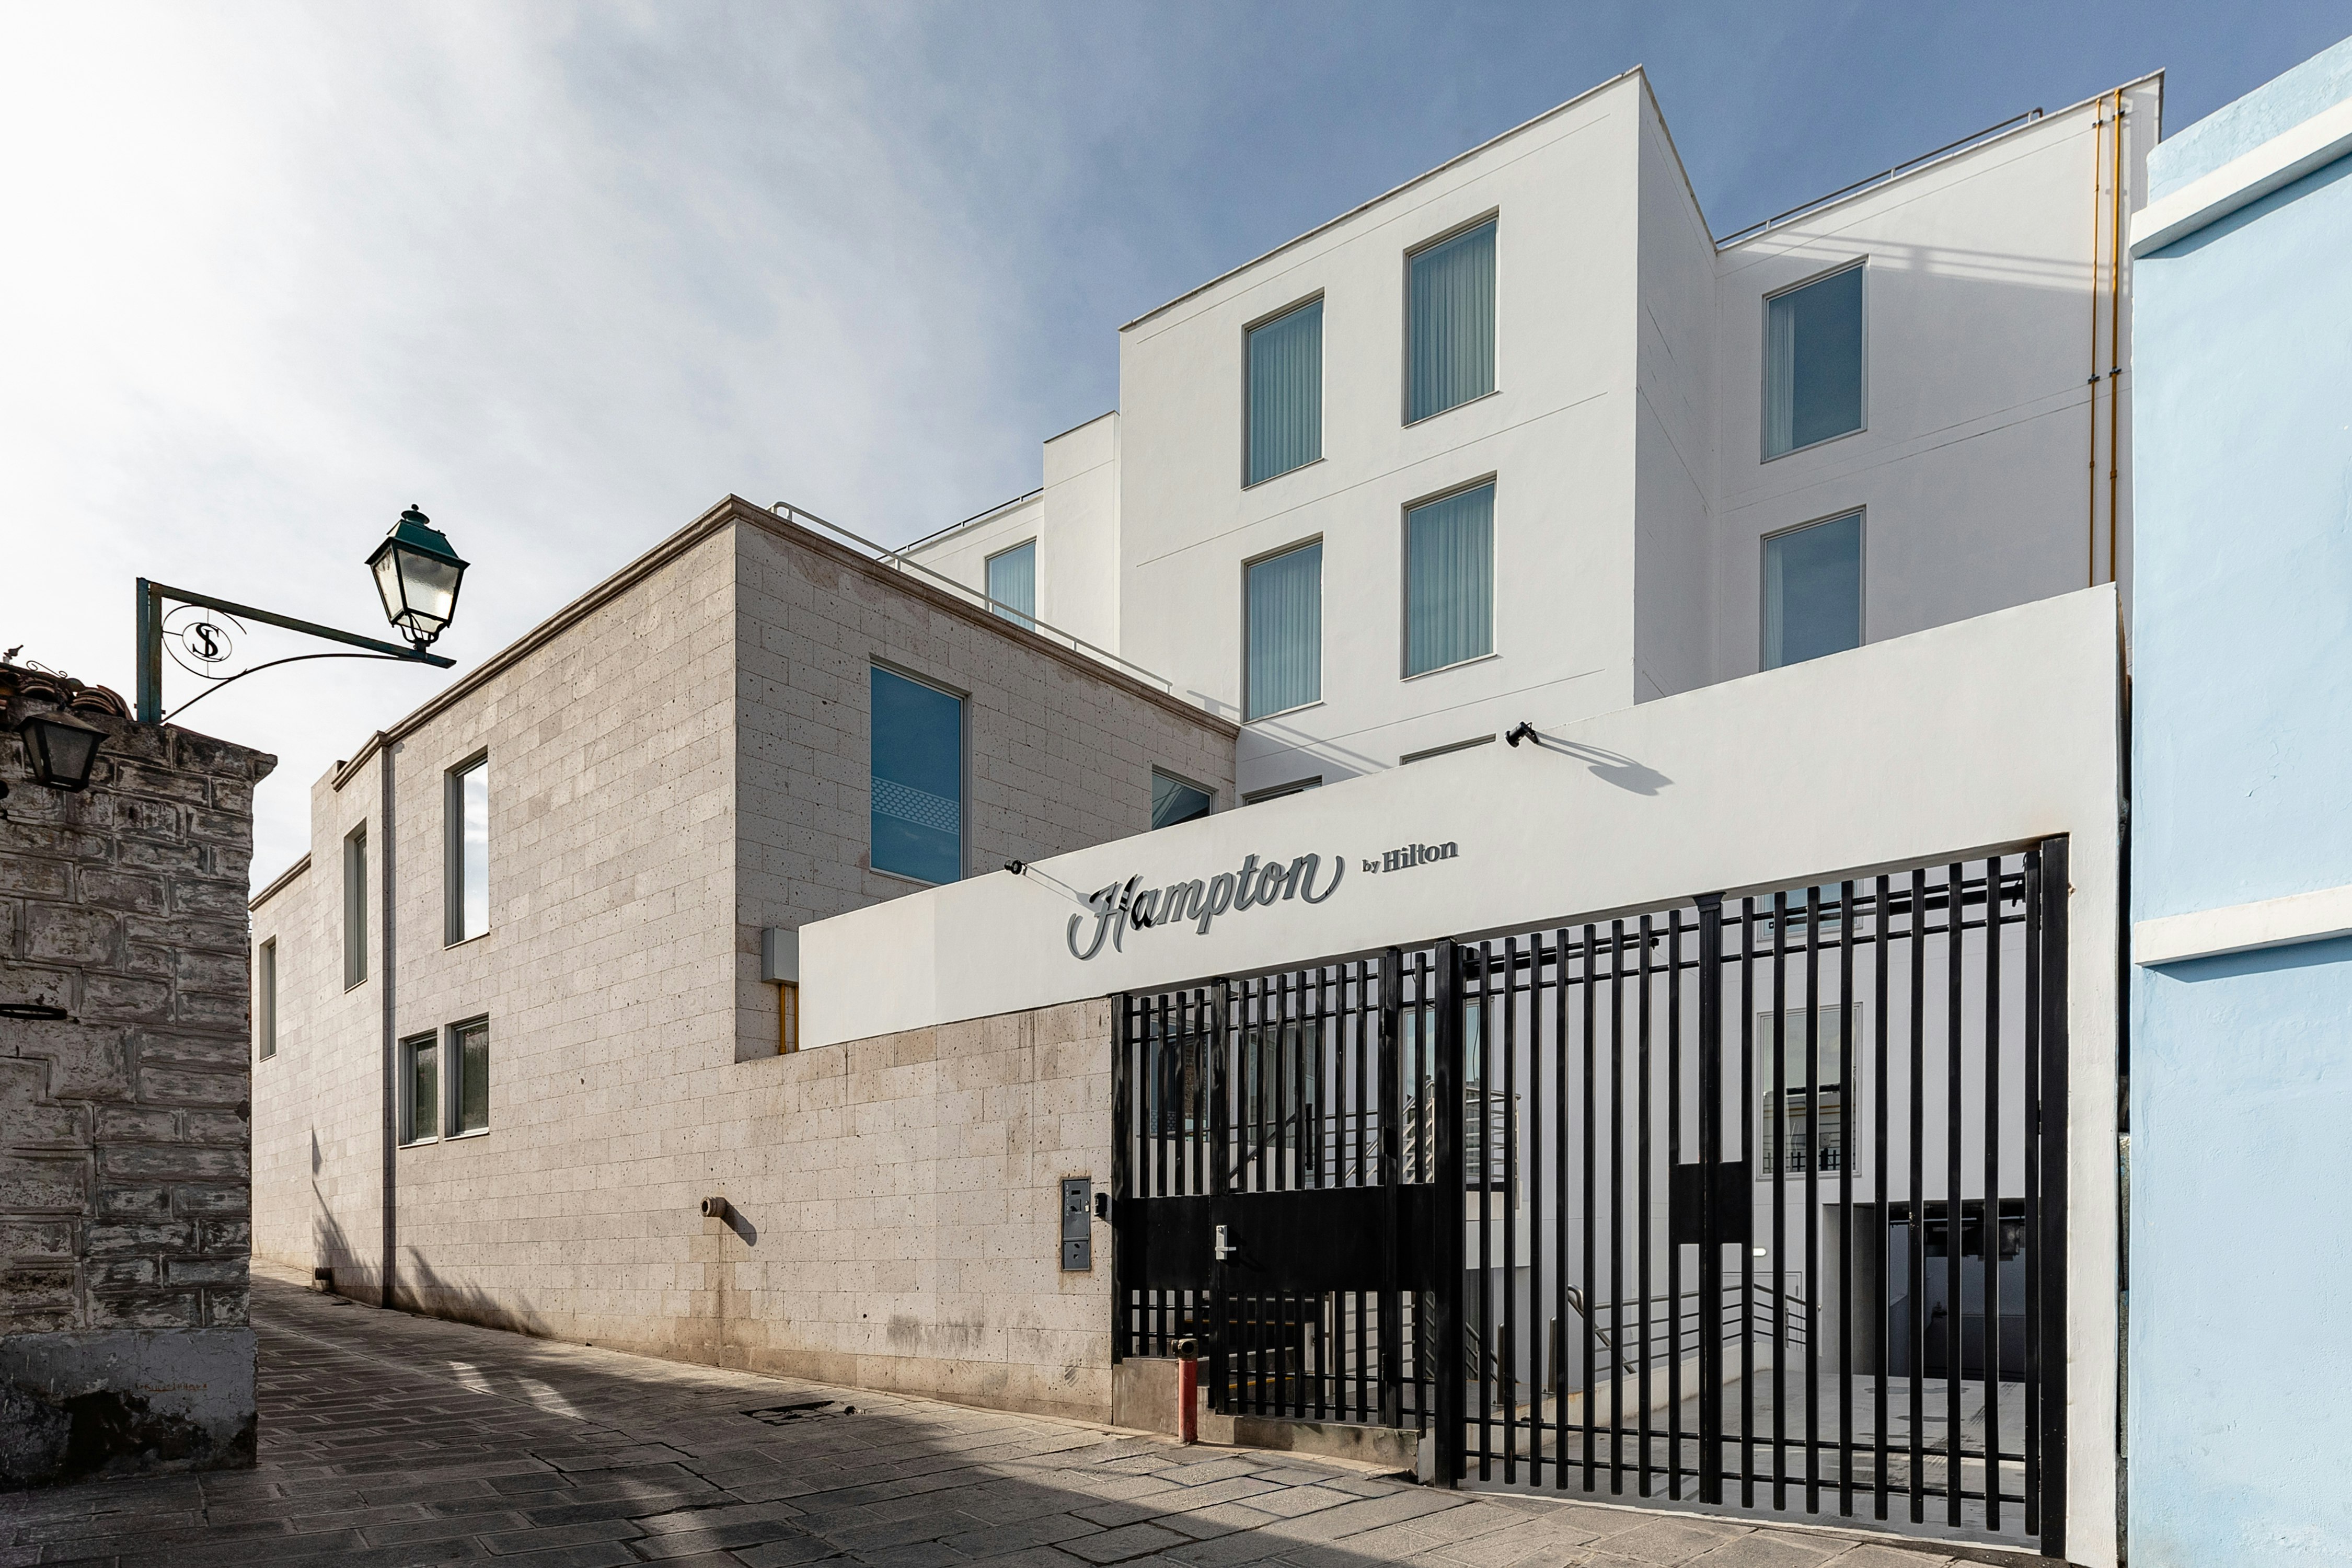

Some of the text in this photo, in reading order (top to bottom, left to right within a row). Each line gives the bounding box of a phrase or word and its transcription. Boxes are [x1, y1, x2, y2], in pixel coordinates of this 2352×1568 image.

[1066, 841, 1459, 960] Hampton by Hilton
